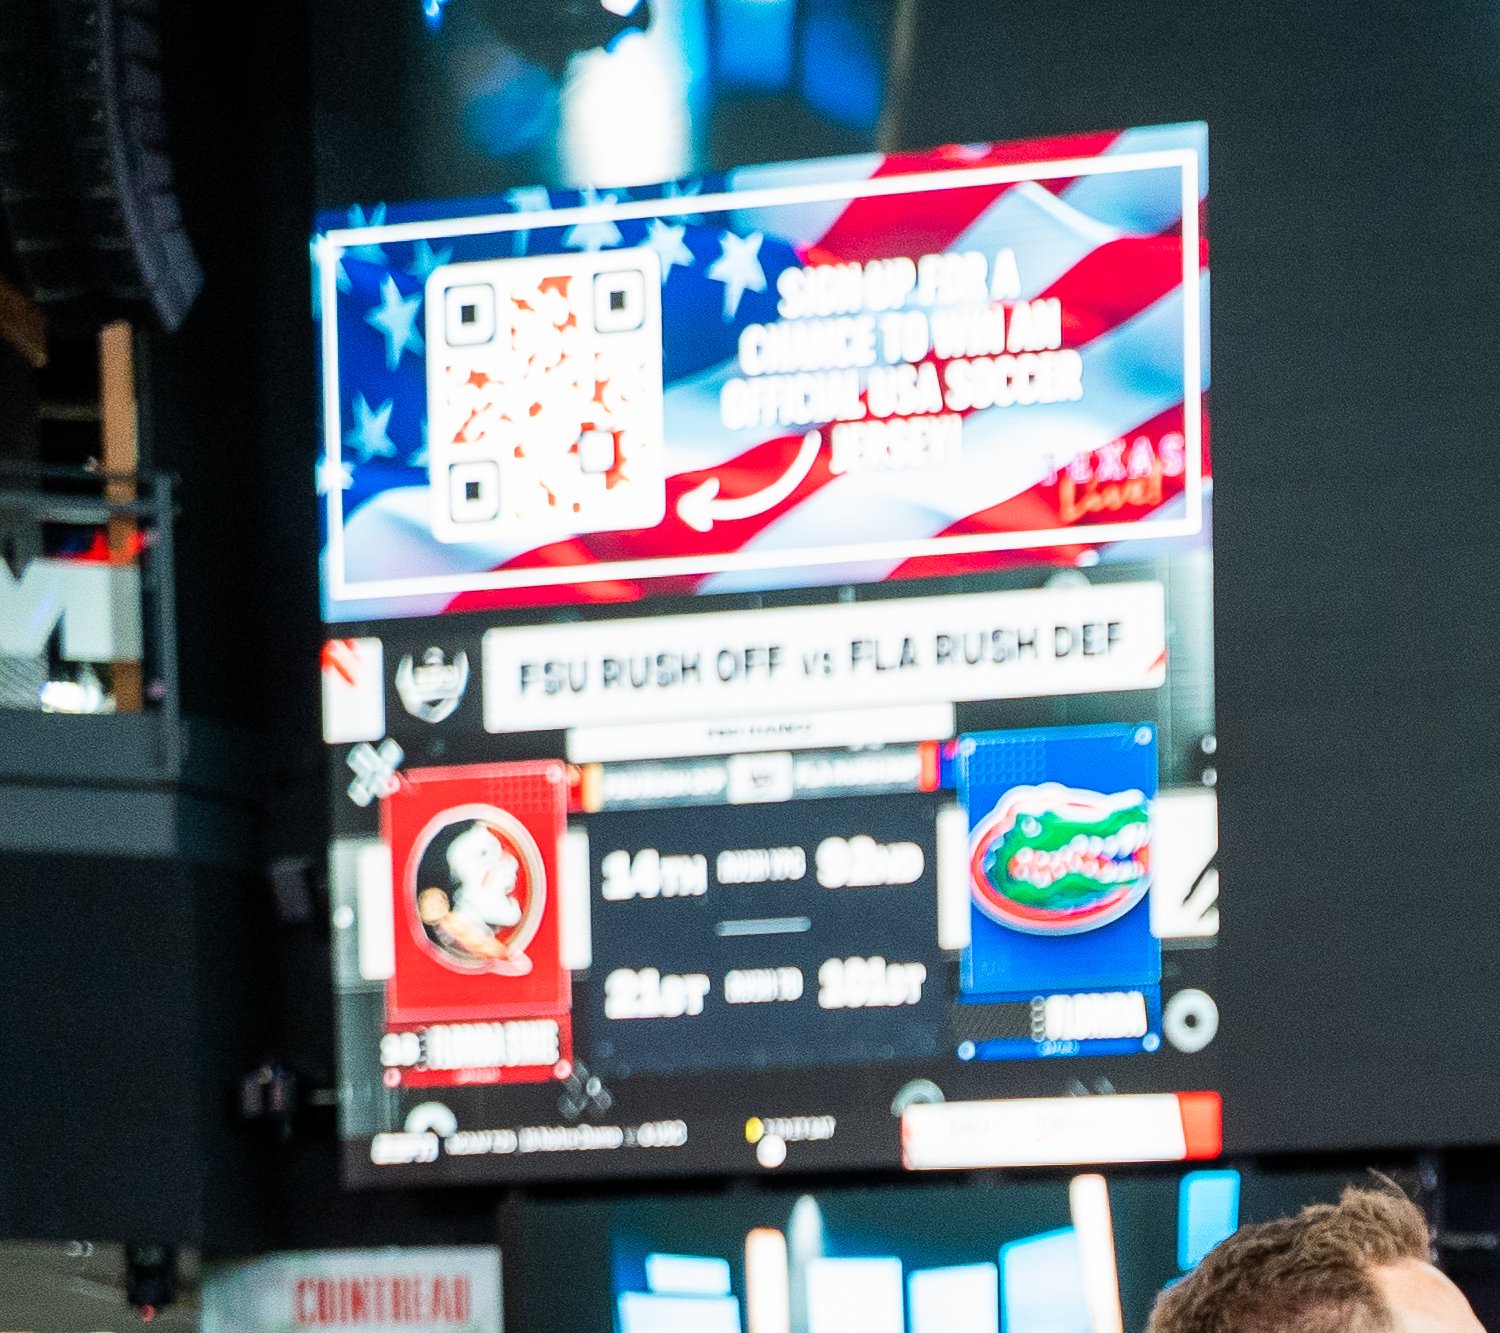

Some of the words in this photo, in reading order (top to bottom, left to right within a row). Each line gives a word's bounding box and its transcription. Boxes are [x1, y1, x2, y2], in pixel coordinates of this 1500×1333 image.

[918, 251, 987, 306] FOR
[991, 247, 1021, 300] A
[879, 310, 928, 363] TO
[867, 363, 942, 416] USA
[945, 350, 1083, 410] SOCCER
[1043, 433, 1185, 486] TEXAS
[519, 660, 587, 695] FSU
[603, 650, 702, 689] RUSH
[717, 645, 782, 682] OFF
[850, 636, 917, 674] FLA
[936, 628, 1037, 665] RUSH
[1054, 621, 1123, 659] DEF
